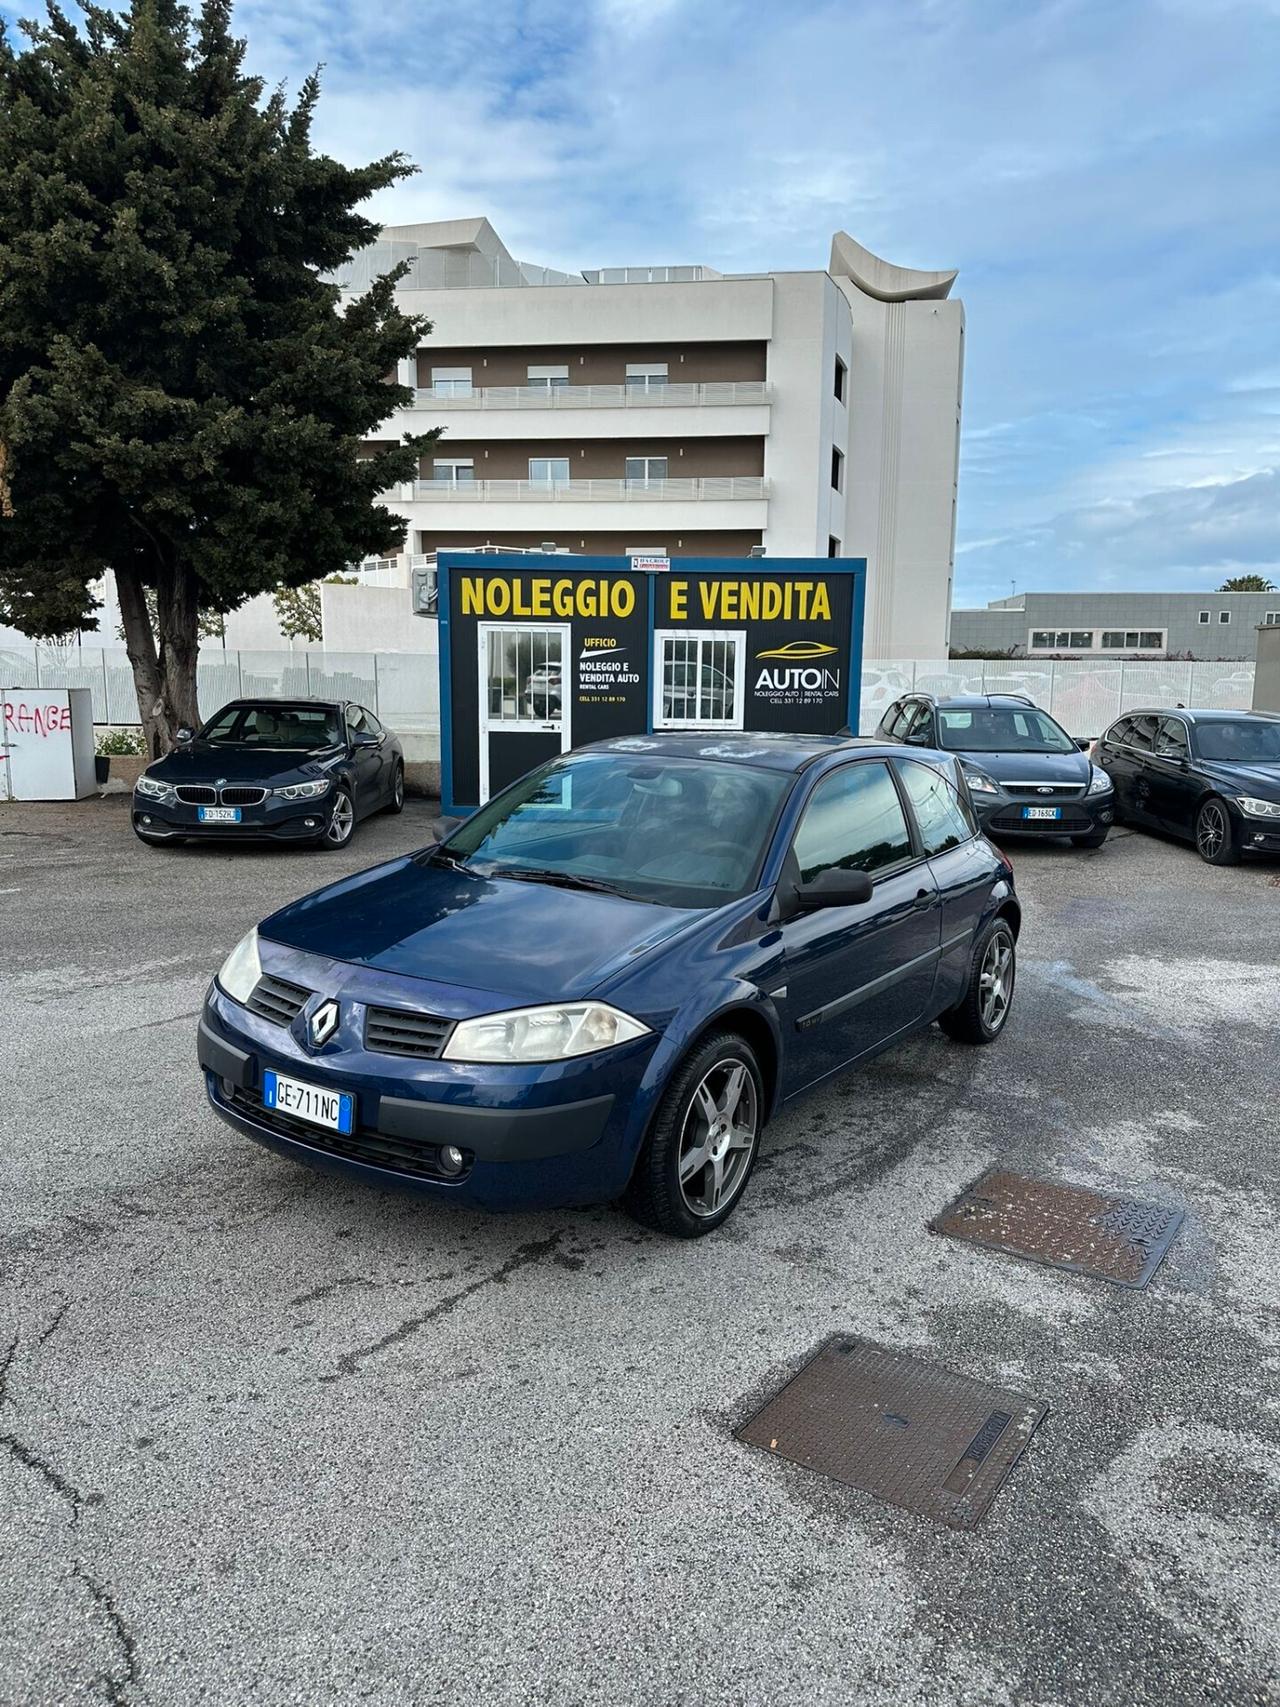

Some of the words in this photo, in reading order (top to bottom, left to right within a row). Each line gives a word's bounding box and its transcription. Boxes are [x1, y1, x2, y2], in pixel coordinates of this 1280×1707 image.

[461, 577, 636, 618] NOLEGGIO
[670, 581, 688, 620] E
[699, 581, 832, 621] VENDITA
[584, 637, 617, 648] UFFICIO
[579, 661, 621, 671] NOLEGGIO
[623, 662, 630, 672] E
[579, 673, 616, 683] VENDITA
[617, 673, 640, 683] AUTO
[754, 667, 841, 690] AUTOIN
